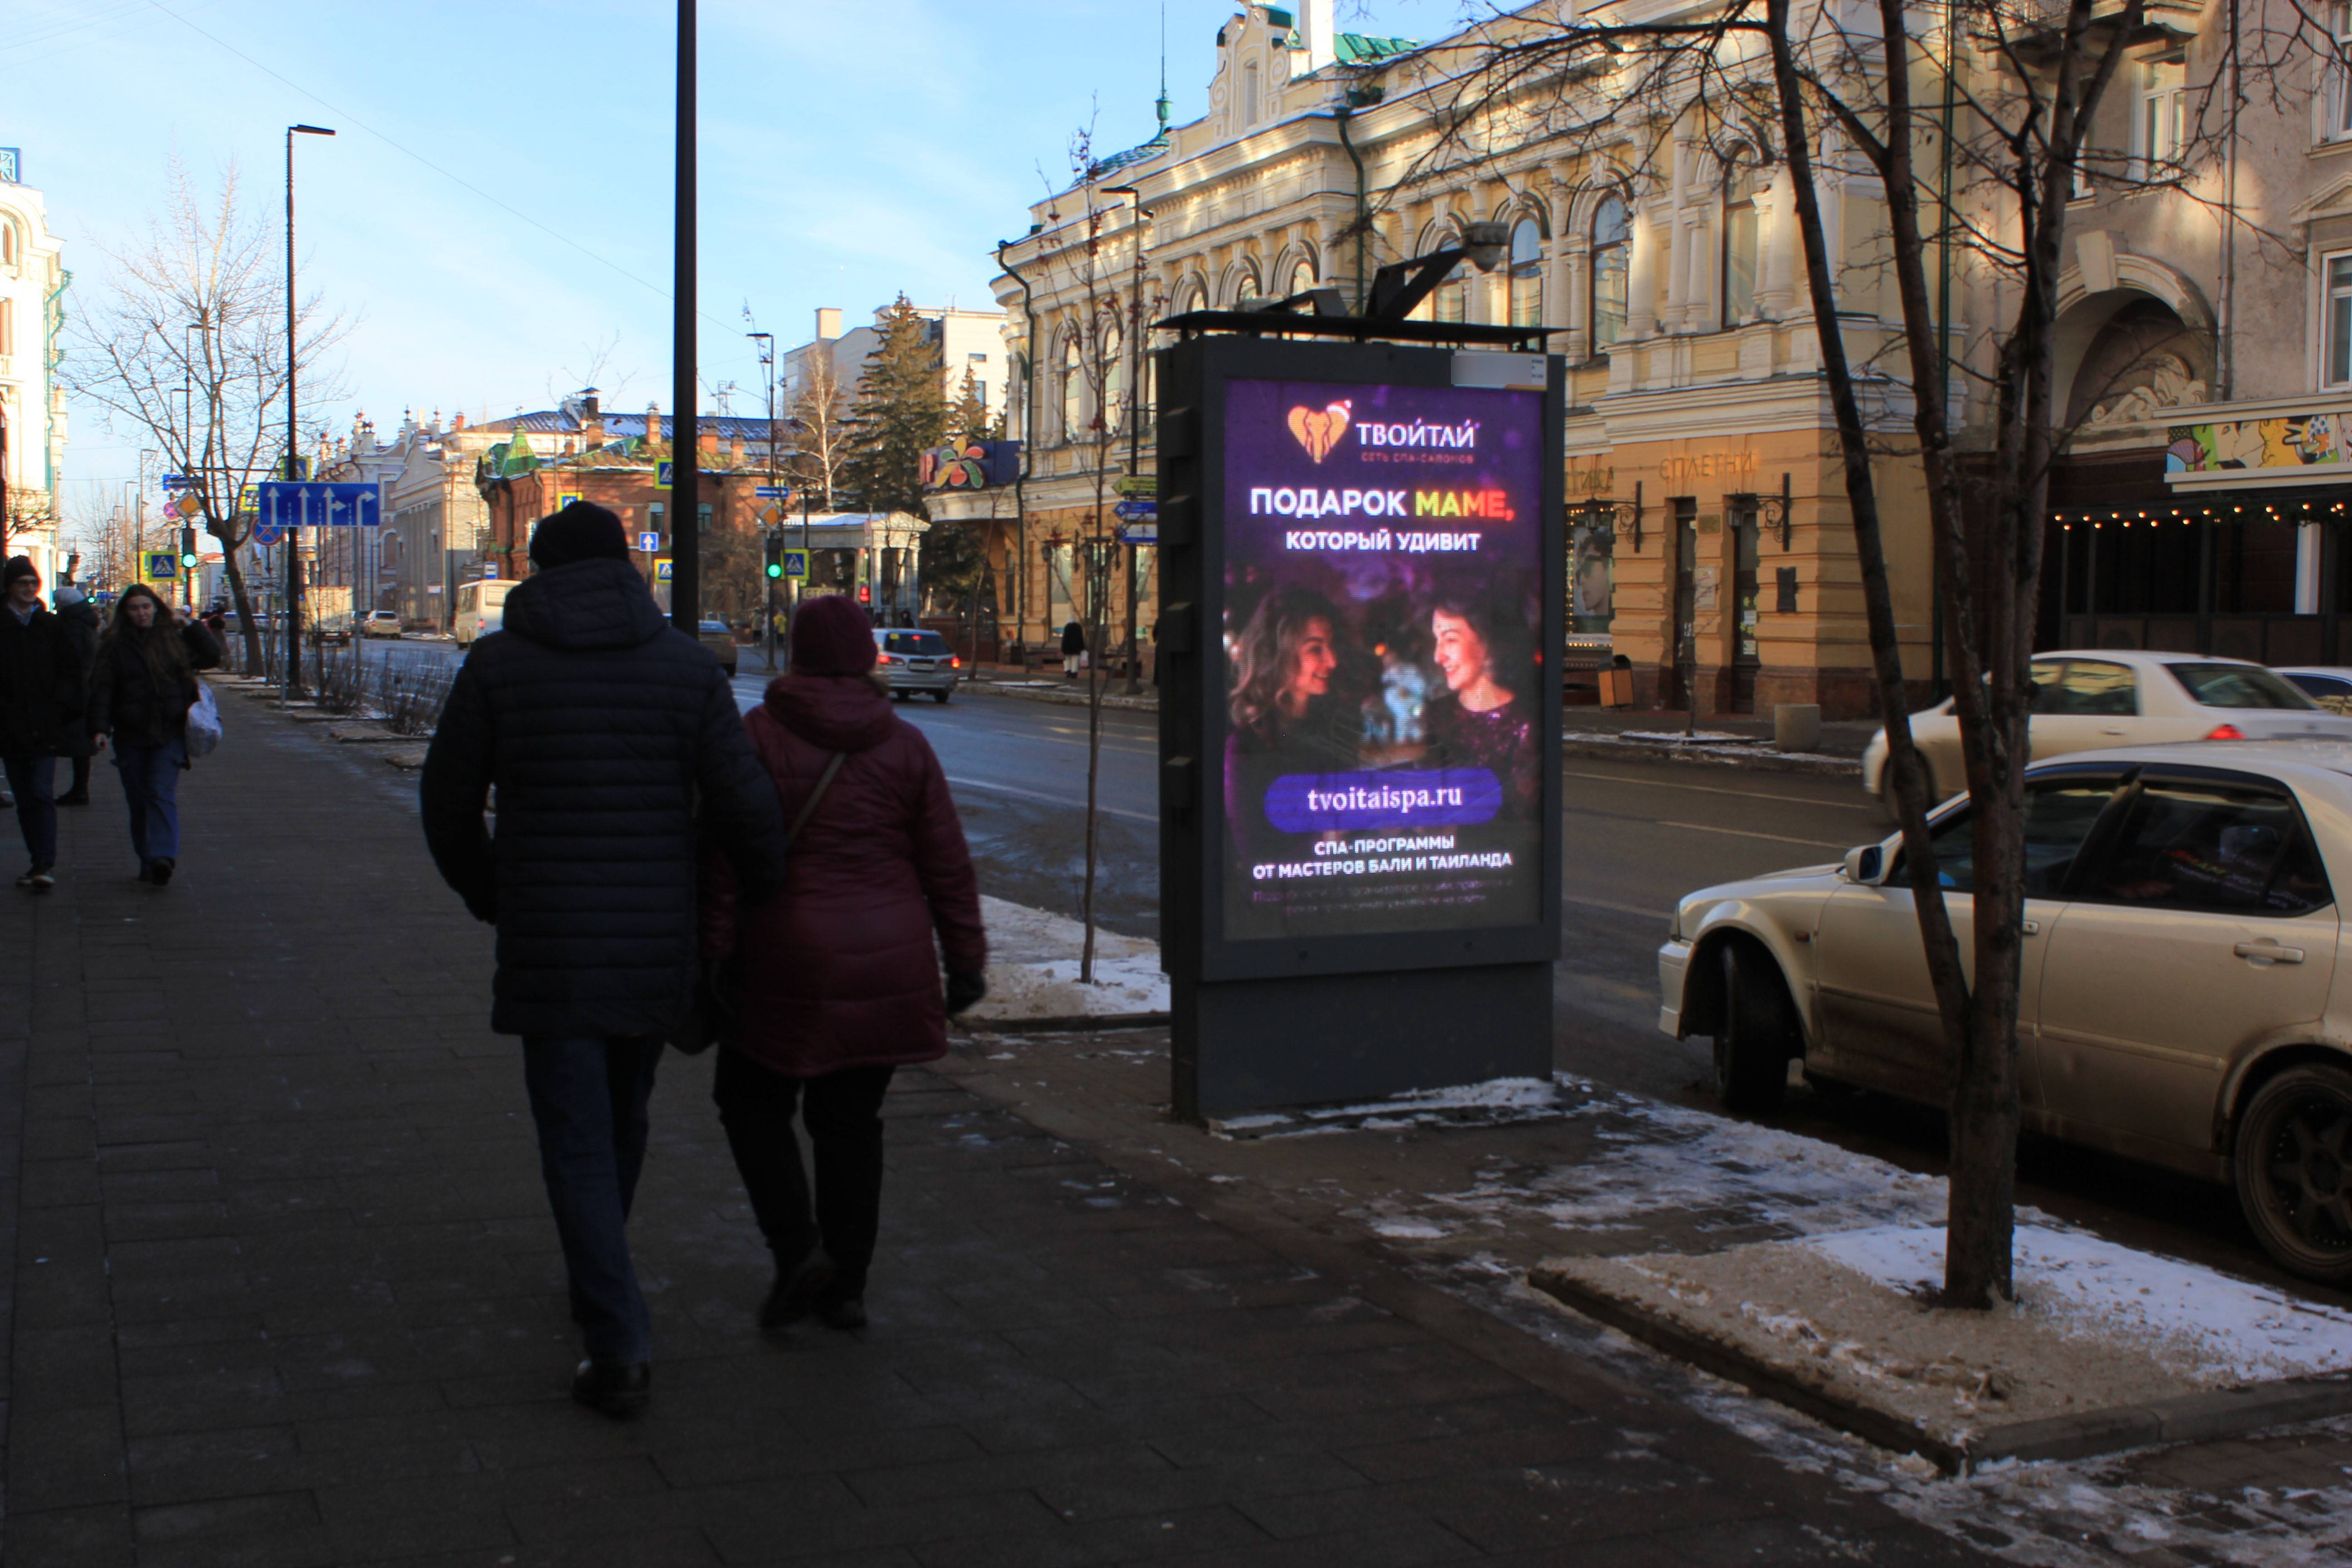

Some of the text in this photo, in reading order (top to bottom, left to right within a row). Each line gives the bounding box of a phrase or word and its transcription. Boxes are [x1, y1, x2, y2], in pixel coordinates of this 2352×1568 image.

[1355, 417, 1475, 448] ТВОЙТАЙ
[1250, 487, 1515, 521] ПОДАРОК МАМЕ,
[1286, 528, 1482, 553] КОТОРЫЙ УДИВИТ
[1308, 786, 1462, 813] tvoitaispa.ru
[1314, 835, 1455, 856] СПА-ПРОГРАММЫ
[1253, 852, 1513, 880] ОТ МАСТЕРОВ БАЛИ И ТАИЛАНДА
